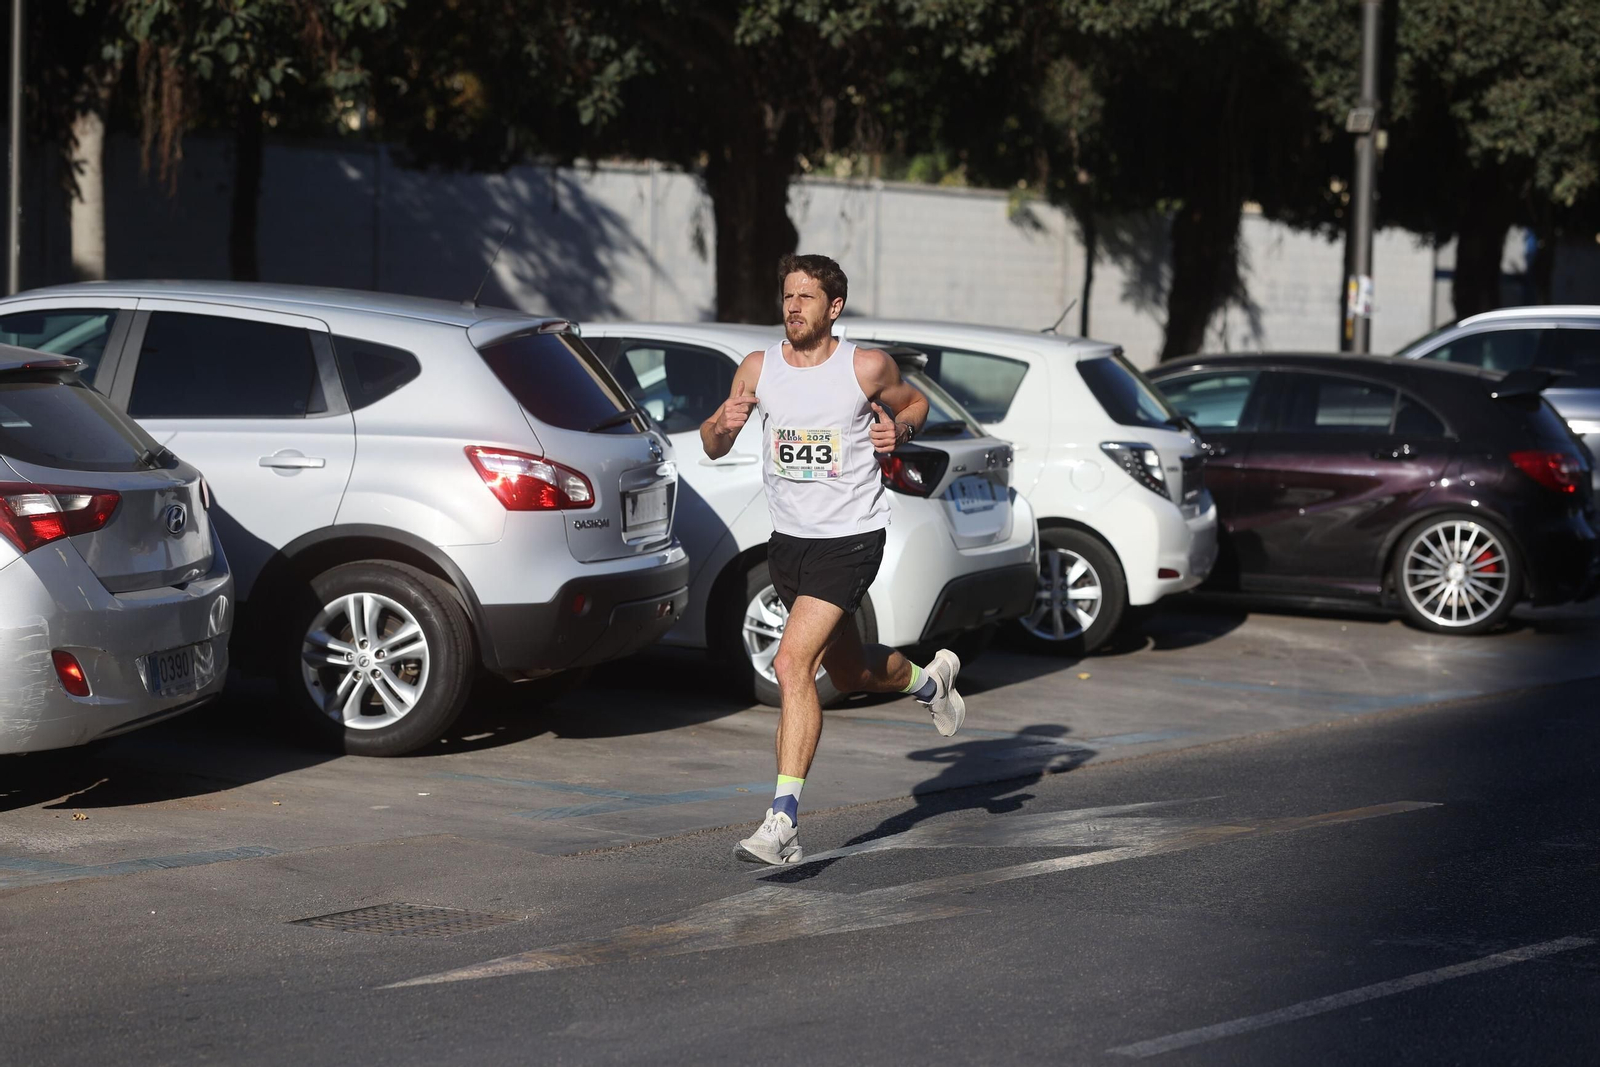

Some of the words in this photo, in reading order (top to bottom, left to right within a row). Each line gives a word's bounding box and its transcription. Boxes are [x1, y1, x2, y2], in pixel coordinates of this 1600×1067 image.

[779, 444, 832, 464] 643
[574, 518, 610, 530] QASHQAI
[159, 652, 189, 682] 0390
